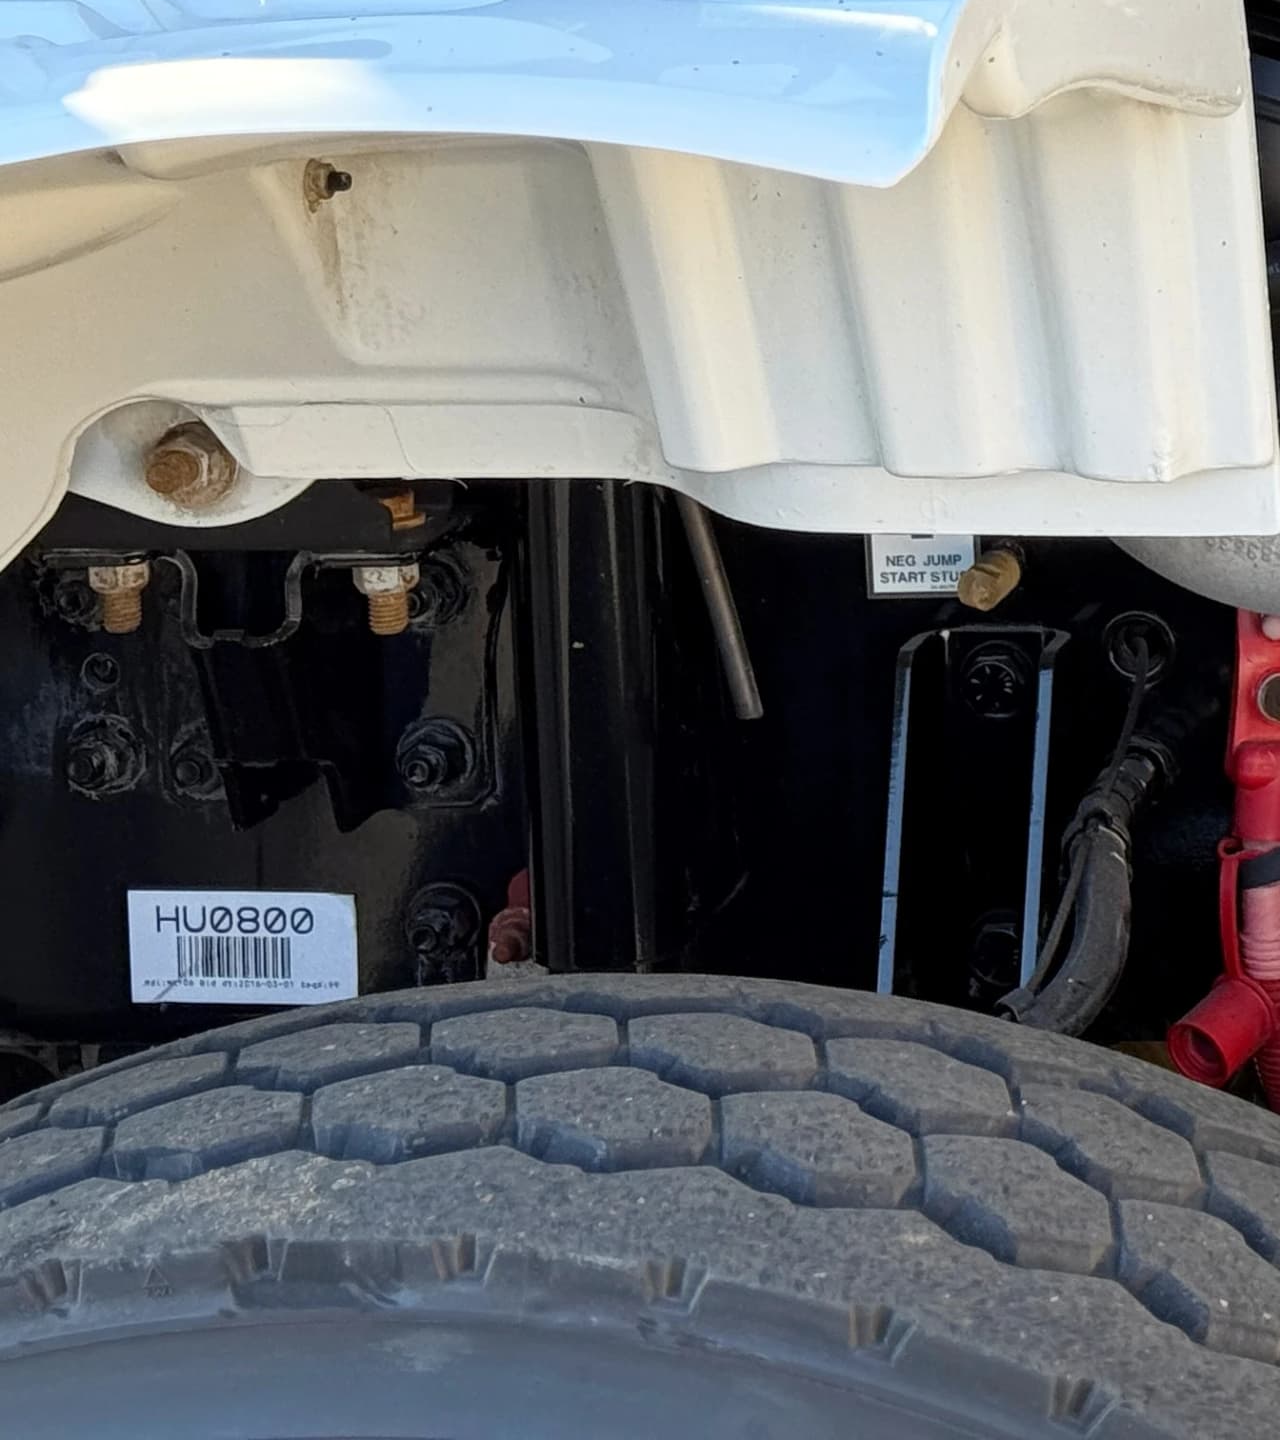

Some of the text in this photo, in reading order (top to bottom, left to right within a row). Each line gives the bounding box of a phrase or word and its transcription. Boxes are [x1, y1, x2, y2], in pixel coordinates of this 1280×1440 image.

[885, 554, 962, 567] NEG JUMP
[880, 571, 965, 584] START STU
[155, 905, 315, 934] HU0800
